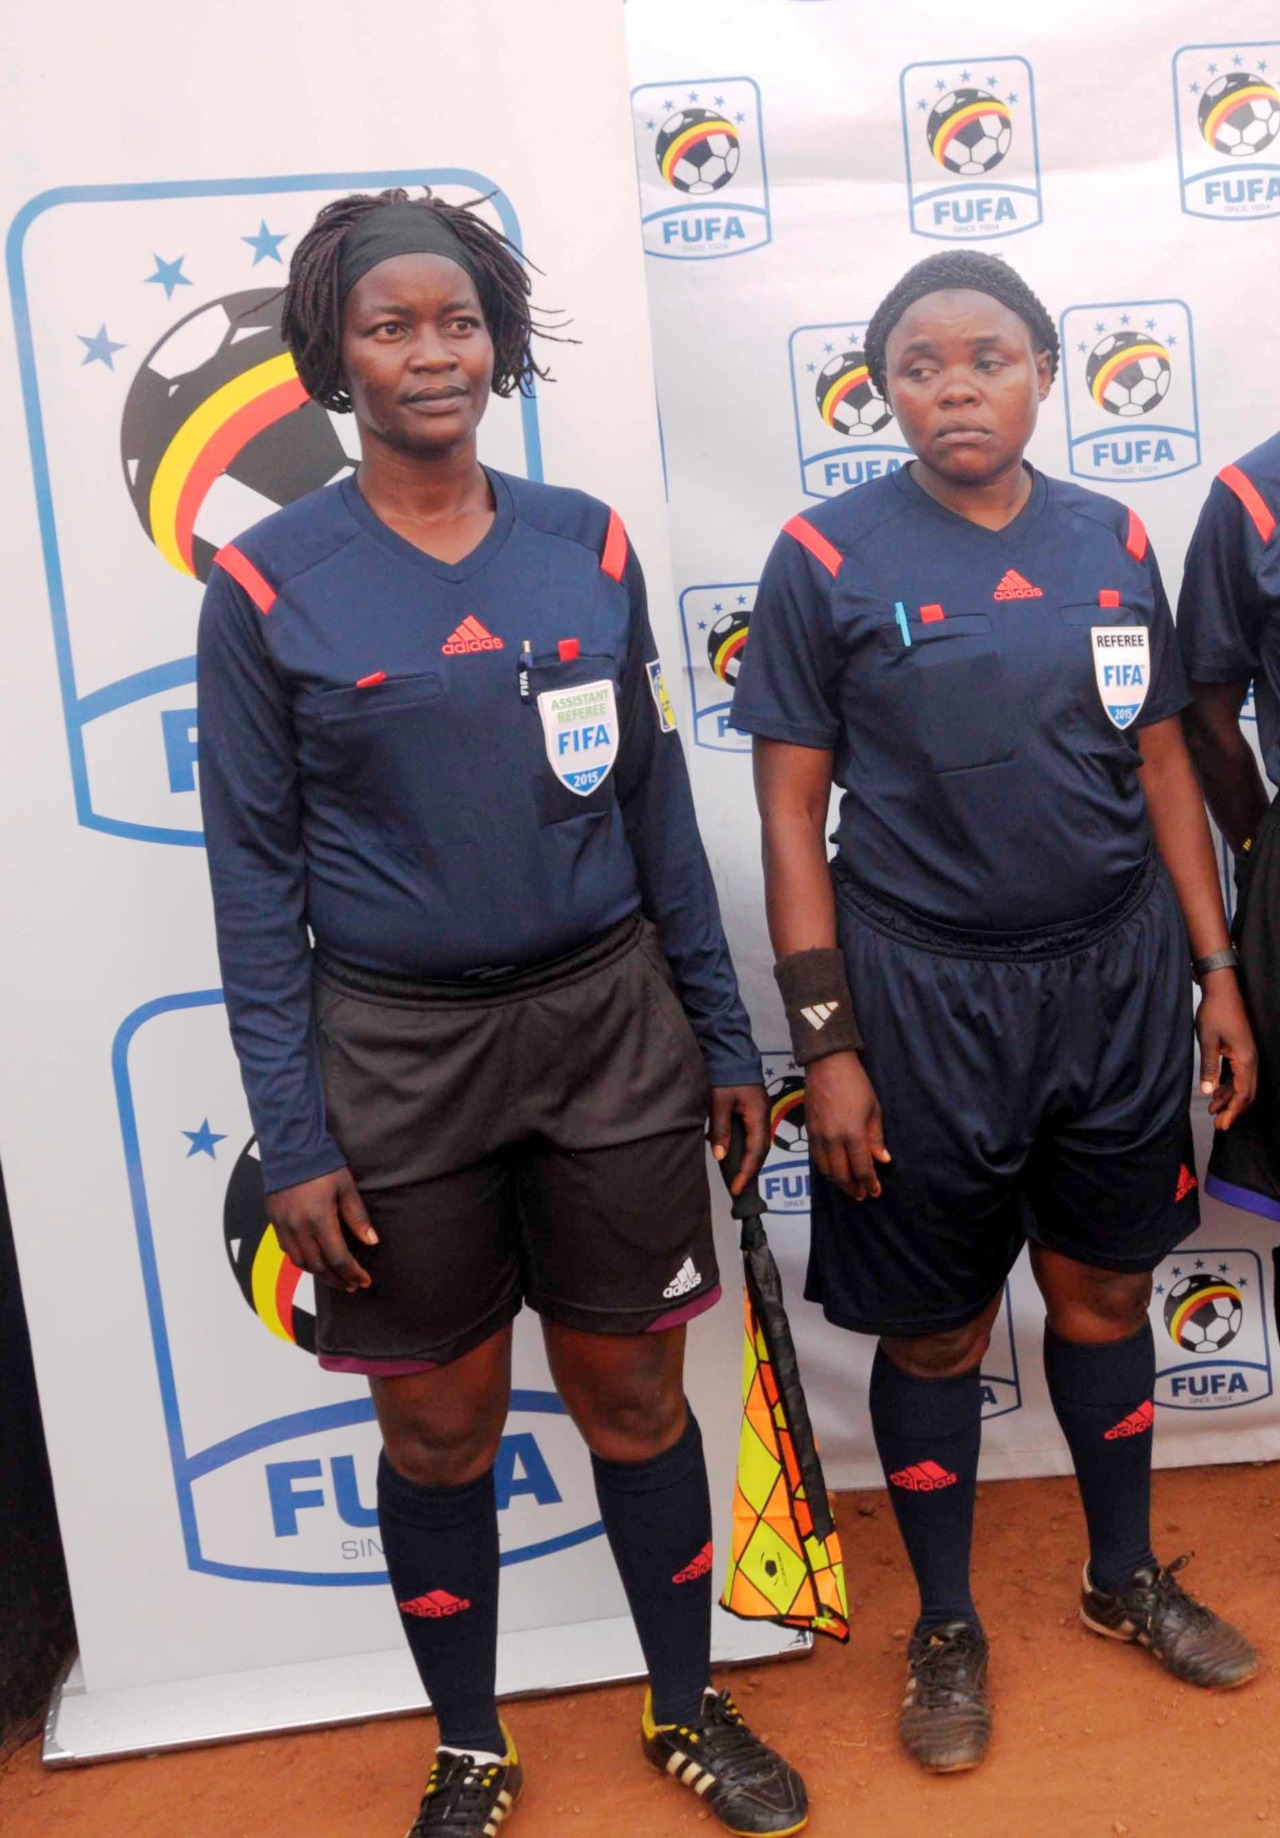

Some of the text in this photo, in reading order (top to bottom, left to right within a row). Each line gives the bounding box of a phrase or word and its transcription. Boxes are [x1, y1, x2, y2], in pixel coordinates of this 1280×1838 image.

[933, 197, 1017, 225] FUFA
[662, 216, 746, 245] FUFA
[1093, 439, 1176, 467] FUFA
[993, 587, 1043, 600] adidas
[442, 637, 504, 655] adidas
[1096, 635, 1144, 648] REFEREE
[519, 671, 530, 697] FIFA
[1103, 665, 1143, 687] FIFA
[552, 690, 609, 711] ASSISTANT
[557, 703, 607, 723] REFEREE
[1115, 708, 1133, 720] 2015
[558, 724, 611, 755] FIFA
[573, 771, 599, 787] 2015
[765, 1175, 811, 1200] FU
[663, 1272, 702, 1298] adidas
[1171, 1372, 1249, 1397] FUFA
[265, 1432, 562, 1537] FUA
[341, 1539, 387, 1560] SIN
